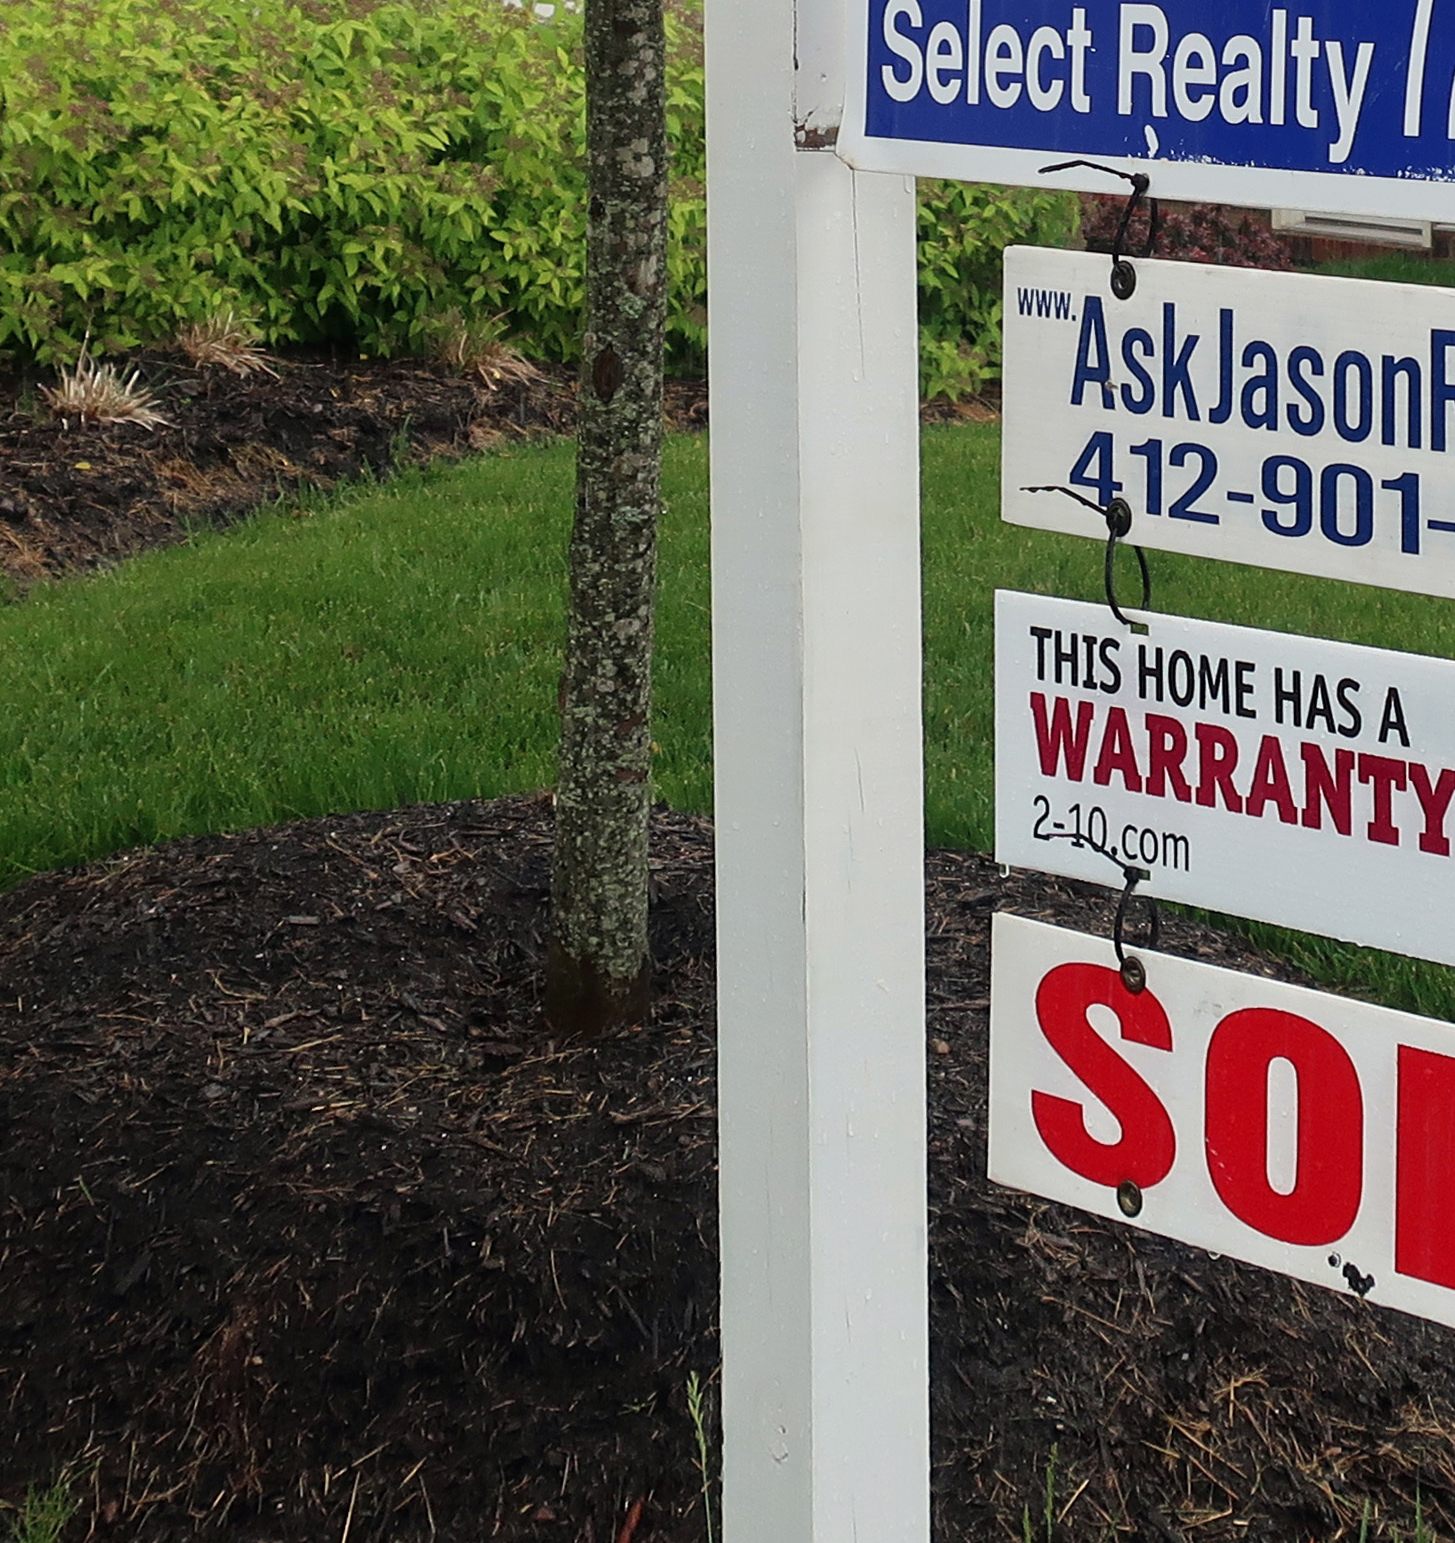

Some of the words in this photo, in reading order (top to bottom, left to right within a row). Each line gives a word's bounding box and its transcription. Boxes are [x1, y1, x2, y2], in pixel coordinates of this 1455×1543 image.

[1118, 3, 1375, 163] Realty
[1030, 626, 1121, 694] THIS
[1138, 644, 1256, 719] HOME
[1274, 667, 1362, 738] HAS
[1378, 687, 1410, 747] A
[1033, 795, 1190, 872] 2-10.com
